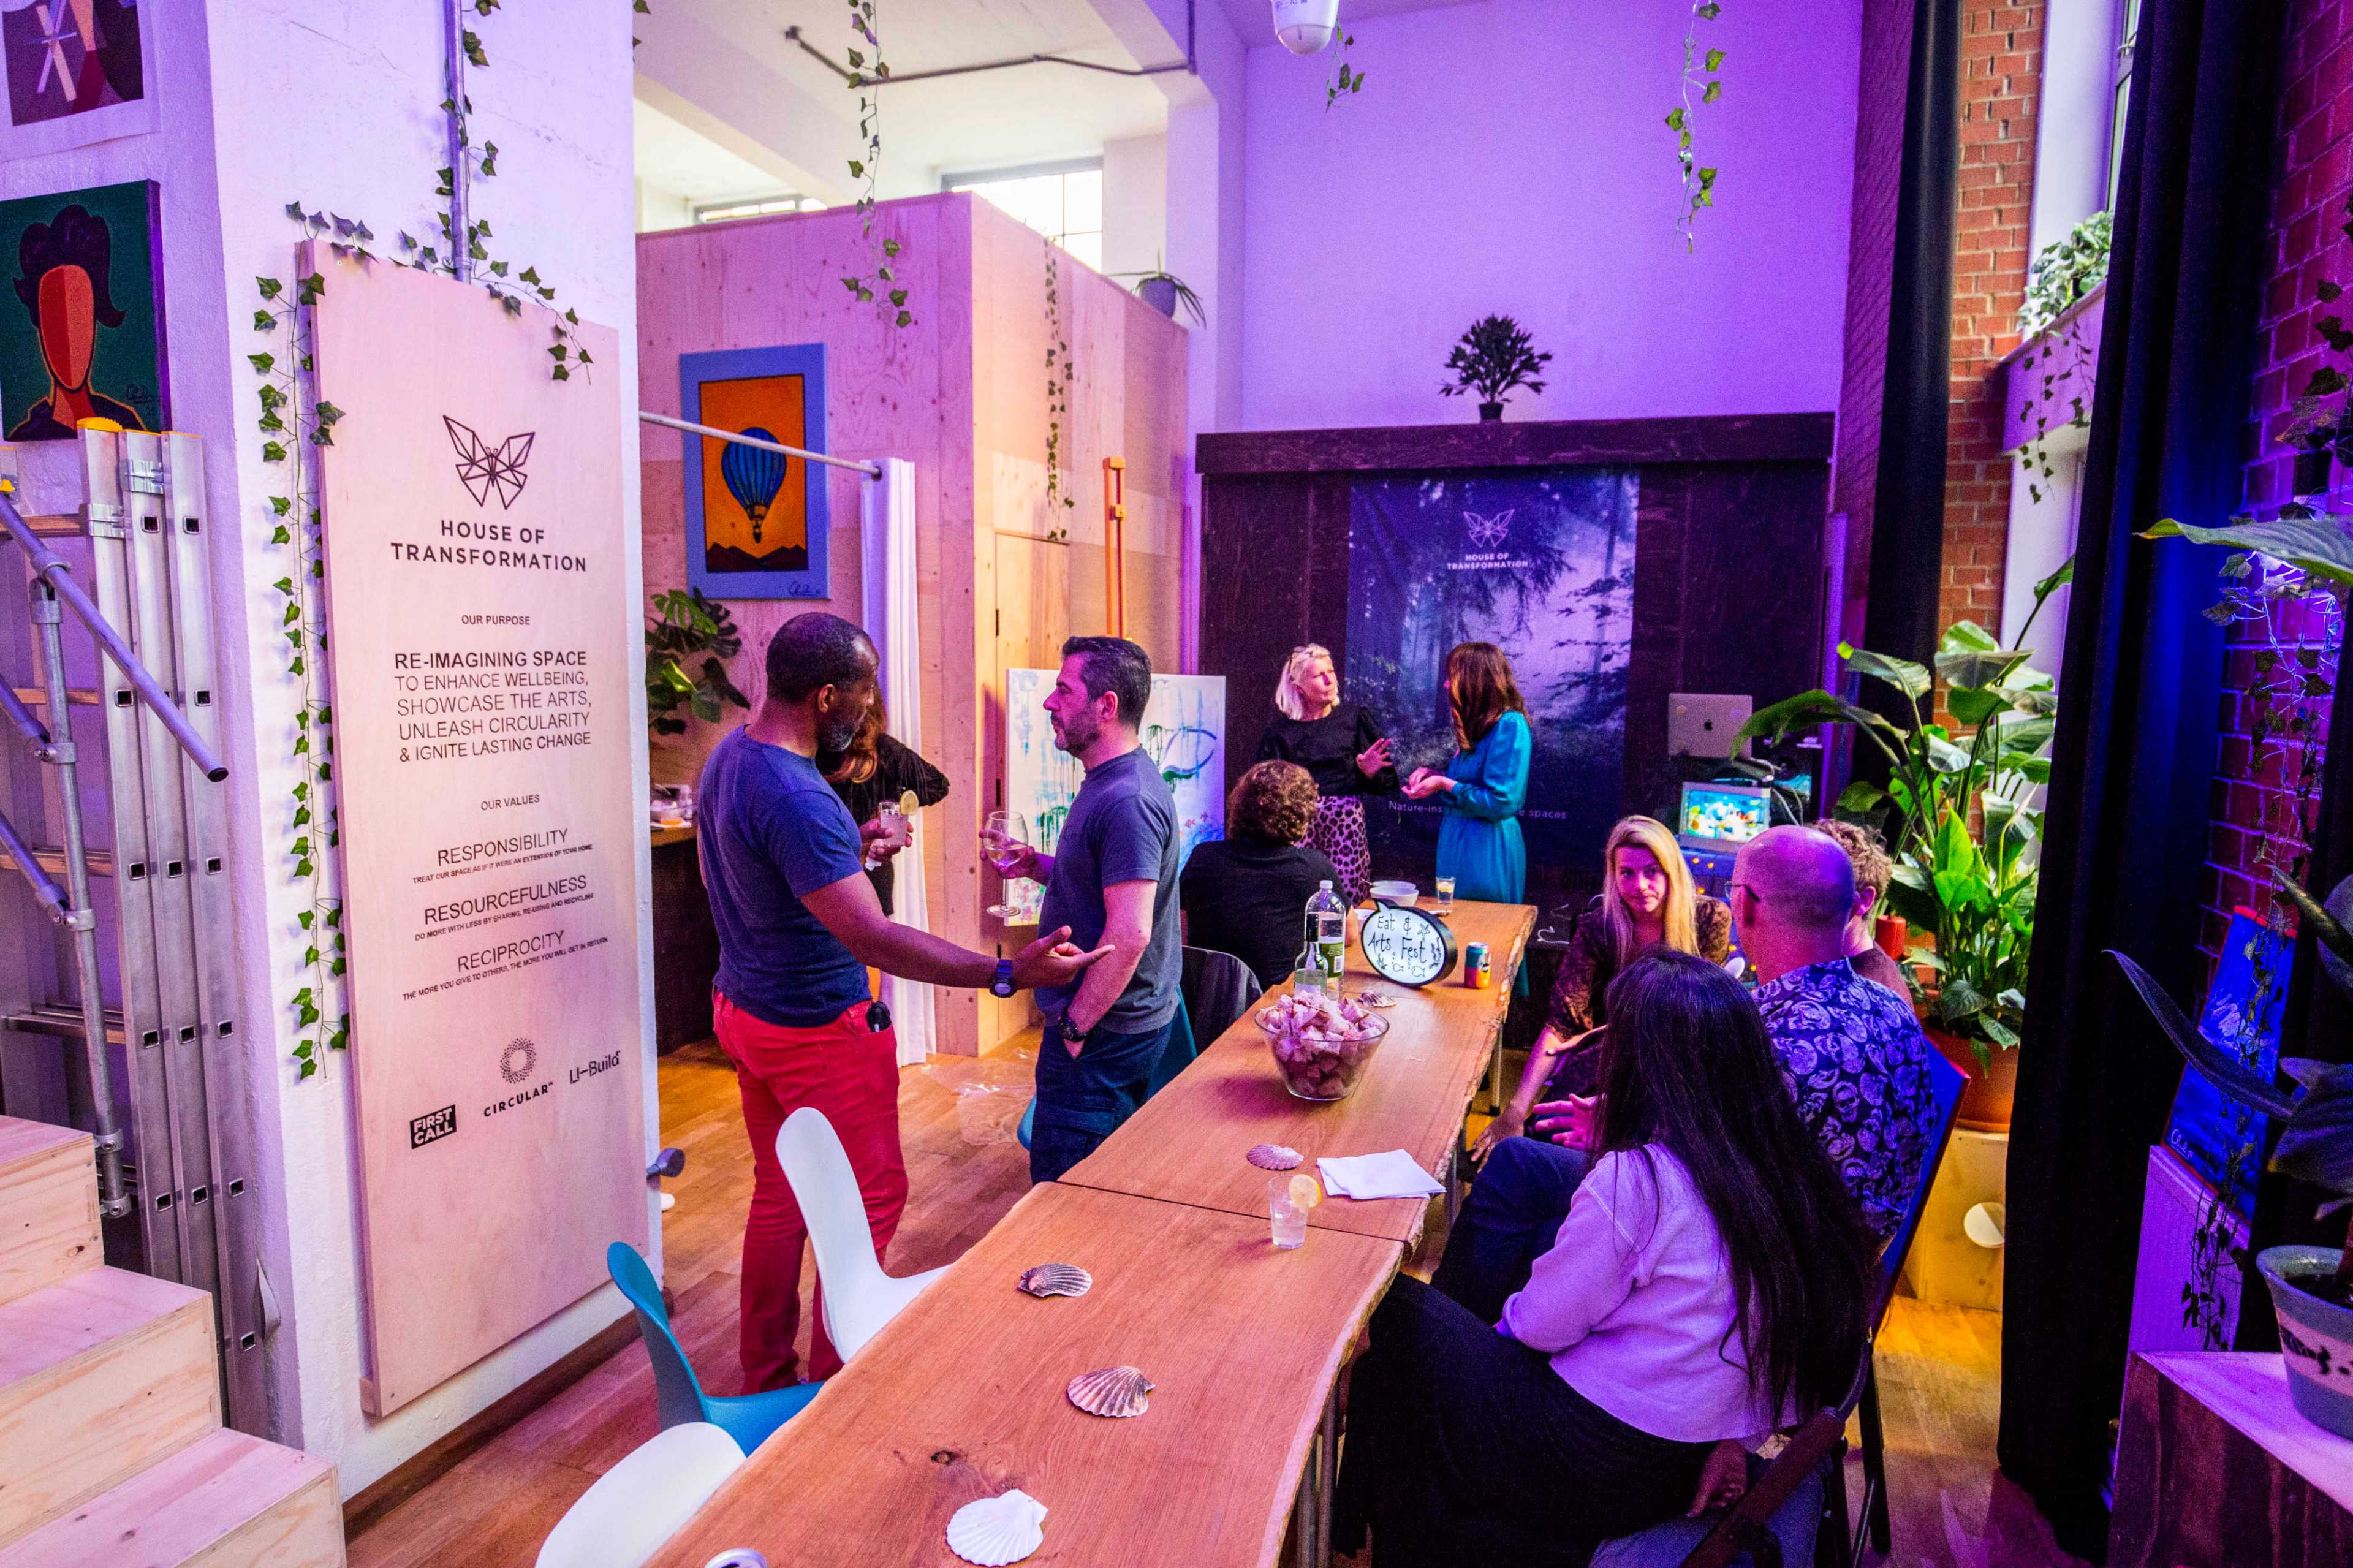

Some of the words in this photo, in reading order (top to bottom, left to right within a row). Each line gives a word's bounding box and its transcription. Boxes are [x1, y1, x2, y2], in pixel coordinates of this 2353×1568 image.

[441, 520, 512, 542] HOUSE
[520, 528, 545, 545] OF
[391, 542, 586, 572] TRANSFORMATION
[1447, 561, 1528, 569] TRANSFORMATION
[461, 615, 483, 625] OUR
[486, 615, 530, 625] PURPOSE
[395, 652, 527, 669] RE-IMAGINING
[533, 651, 587, 666] SPACE
[395, 676, 418, 691] TO
[425, 673, 500, 690] ENHANCE
[504, 671, 589, 687] WELLBEING,
[397, 695, 504, 716] SHOWCASE
[510, 693, 542, 709] THE
[547, 691, 592, 708] ARTS,
[399, 719, 483, 740] UNLEASH
[489, 711, 591, 733] CIRCULARITY
[400, 747, 410, 762] &
[416, 743, 468, 761] IGNITE
[472, 737, 532, 756] LASTING
[537, 732, 591, 749] CHANGE
[481, 799, 501, 811] OUR
[505, 794, 540, 807] VALUES
[1388, 800, 1443, 813] Nature-ins
[1529, 809, 1566, 819] spaces
[438, 828, 568, 866] RESPONSIBILITY
[413, 874, 434, 884] TREAT
[451, 868, 471, 876] SPACE
[523, 852, 553, 863] EXTENSION
[425, 875, 586, 925] RESOURCEFULNESS
[427, 928, 446, 939] MORE
[448, 924, 464, 933] WITH
[466, 920, 482, 928] LESS
[493, 911, 521, 922] SHARING,
[523, 904, 550, 914] RE-USING
[564, 893, 594, 904] RECYCLING
[1377, 913, 1395, 931] Eat
[458, 930, 564, 972] RECIPROCITY
[1368, 931, 1391, 955] Arts
[1401, 936, 1427, 963] Fest
[403, 991, 416, 1001] THE
[418, 985, 438, 996] MORE
[440, 981, 454, 990] YOU
[456, 976, 471, 985] GIVE
[482, 966, 509, 977] OTHERS,
[523, 956, 540, 966] MORE
[587, 936, 608, 947] RETURN
[414, 1108, 452, 1133] FIRST
[414, 1121, 453, 1145] CALL
